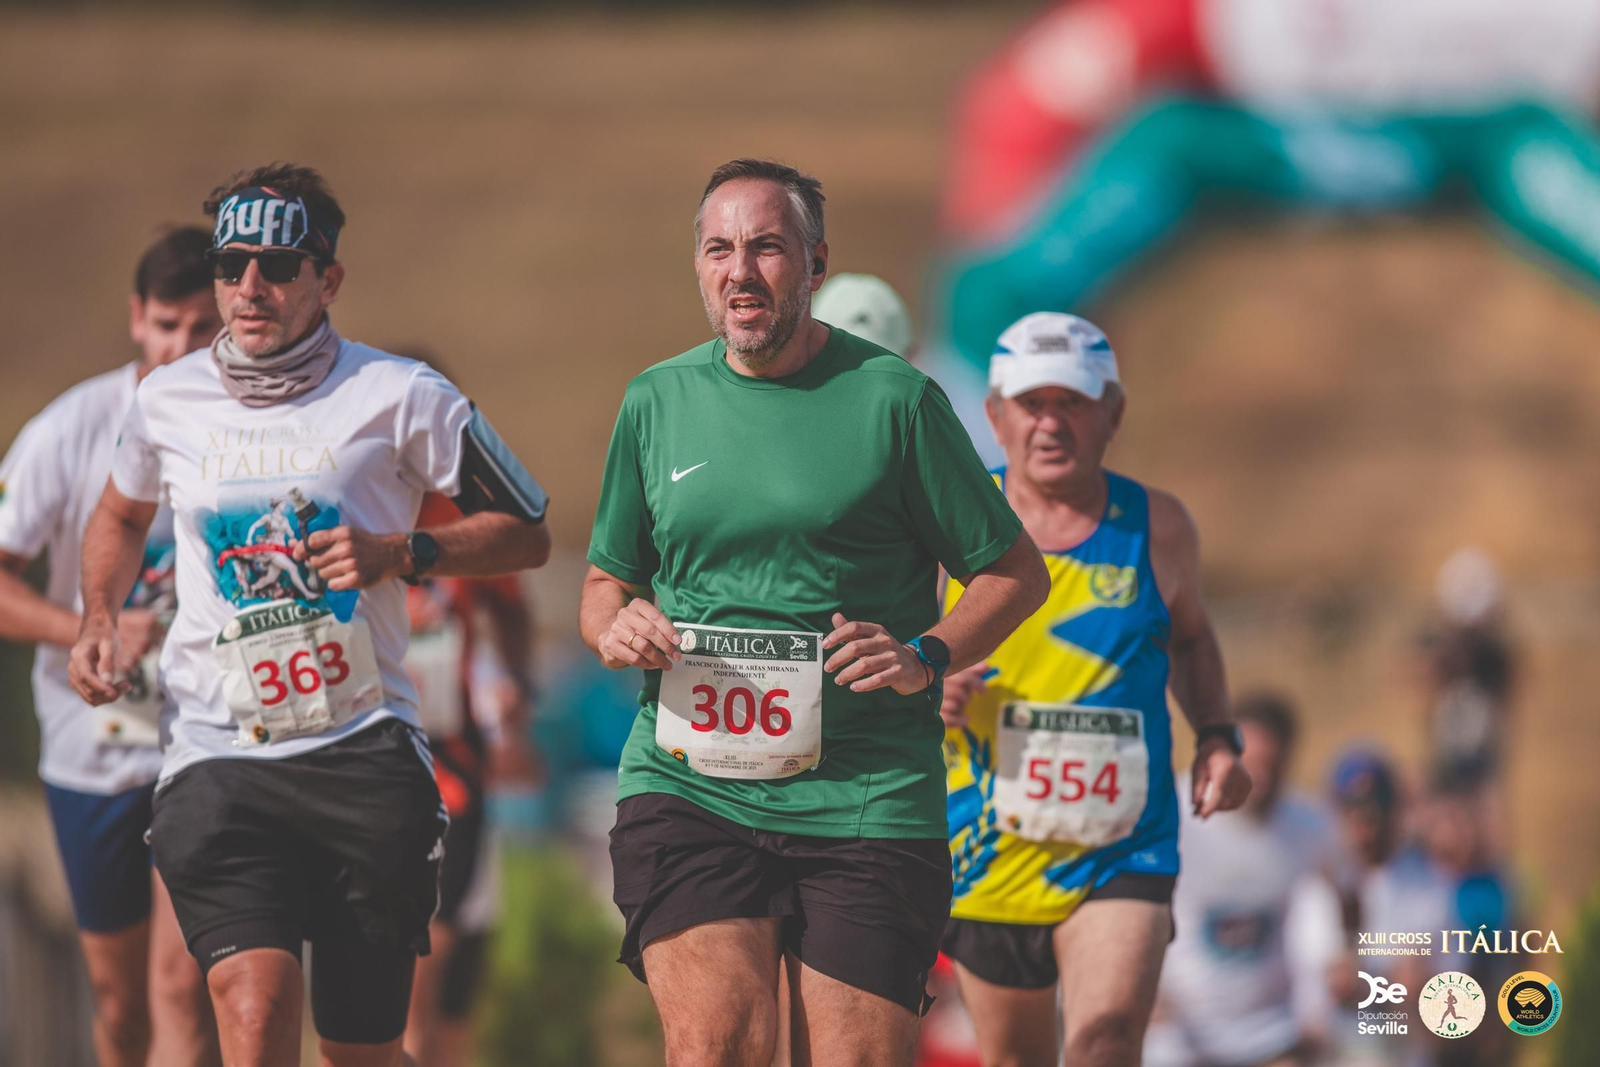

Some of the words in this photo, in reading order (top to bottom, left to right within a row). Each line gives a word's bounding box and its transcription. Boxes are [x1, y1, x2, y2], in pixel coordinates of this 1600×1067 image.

[705, 634, 777, 654] ITÁLICA
[253, 641, 350, 707] 363
[685, 660, 719, 669] FRANCISCO
[720, 662, 744, 671] JAVIER
[745, 664, 766, 672] ARIAS
[767, 665, 800, 673] MIRANDA
[713, 670, 766, 679] INDEPENDIENTE
[690, 684, 792, 737] 306
[1026, 758, 1121, 804] 554
